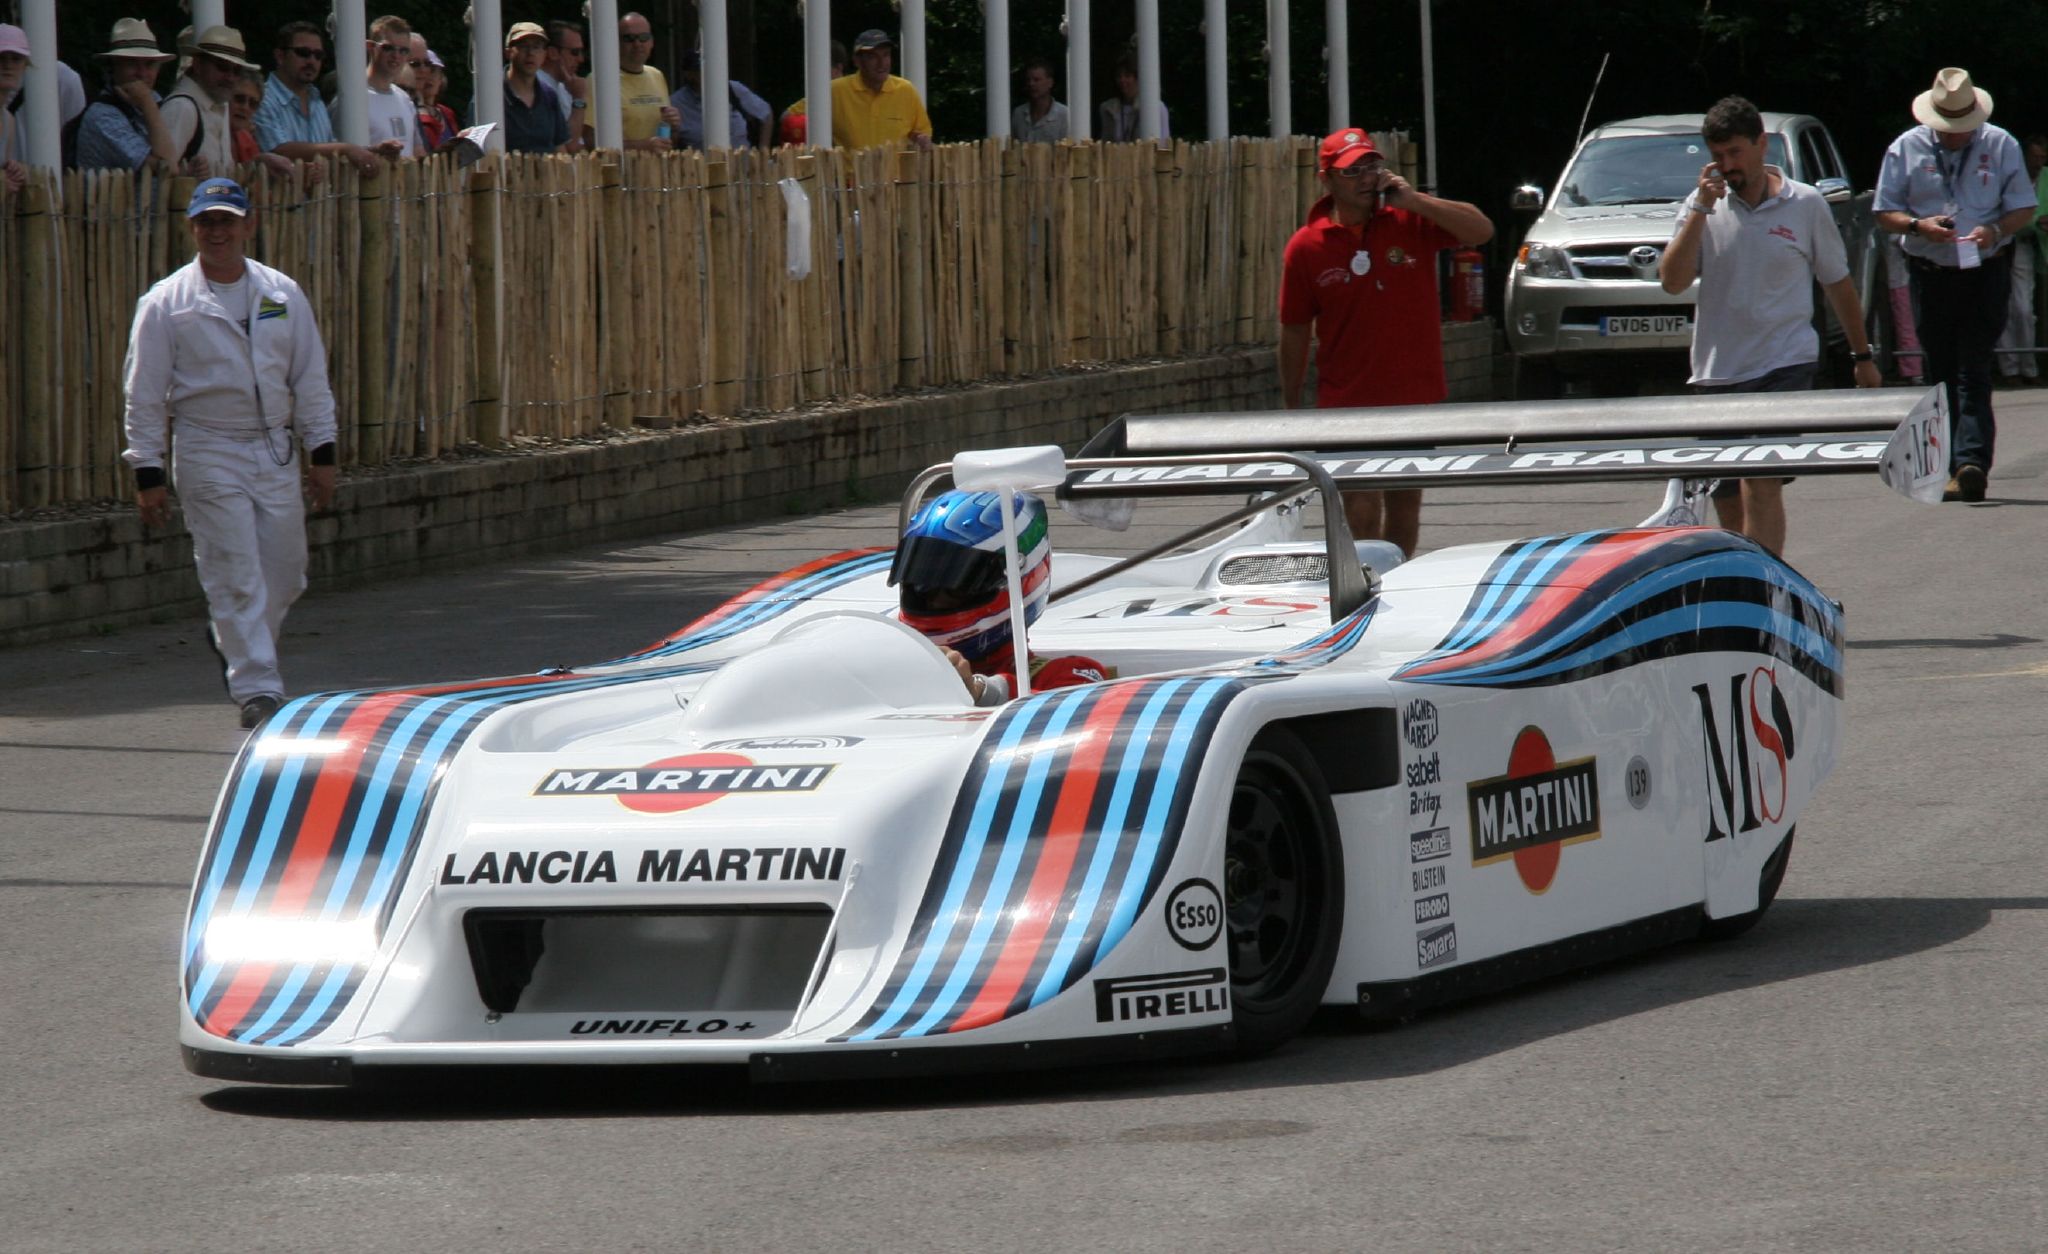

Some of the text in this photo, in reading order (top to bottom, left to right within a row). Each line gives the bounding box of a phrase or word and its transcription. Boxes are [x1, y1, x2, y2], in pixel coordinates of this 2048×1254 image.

[1609, 318, 1685, 333] GV06 UYF
[1083, 441, 1888, 482] MARTINI RACING
[1407, 752, 1441, 788] sabelt
[1692, 666, 1787, 843] MS
[544, 764, 826, 792] MARTINI
[1629, 769, 1647, 798] 139
[1410, 791, 1442, 827] Britax
[1477, 773, 1592, 848] MARTINI
[439, 848, 847, 885] LANCIA MARTINI
[1412, 865, 1446, 892] BILSTEIN
[1415, 896, 1448, 920] FERODO
[1419, 931, 1456, 964] Savara
[1093, 967, 1227, 1023] PIRELLI
